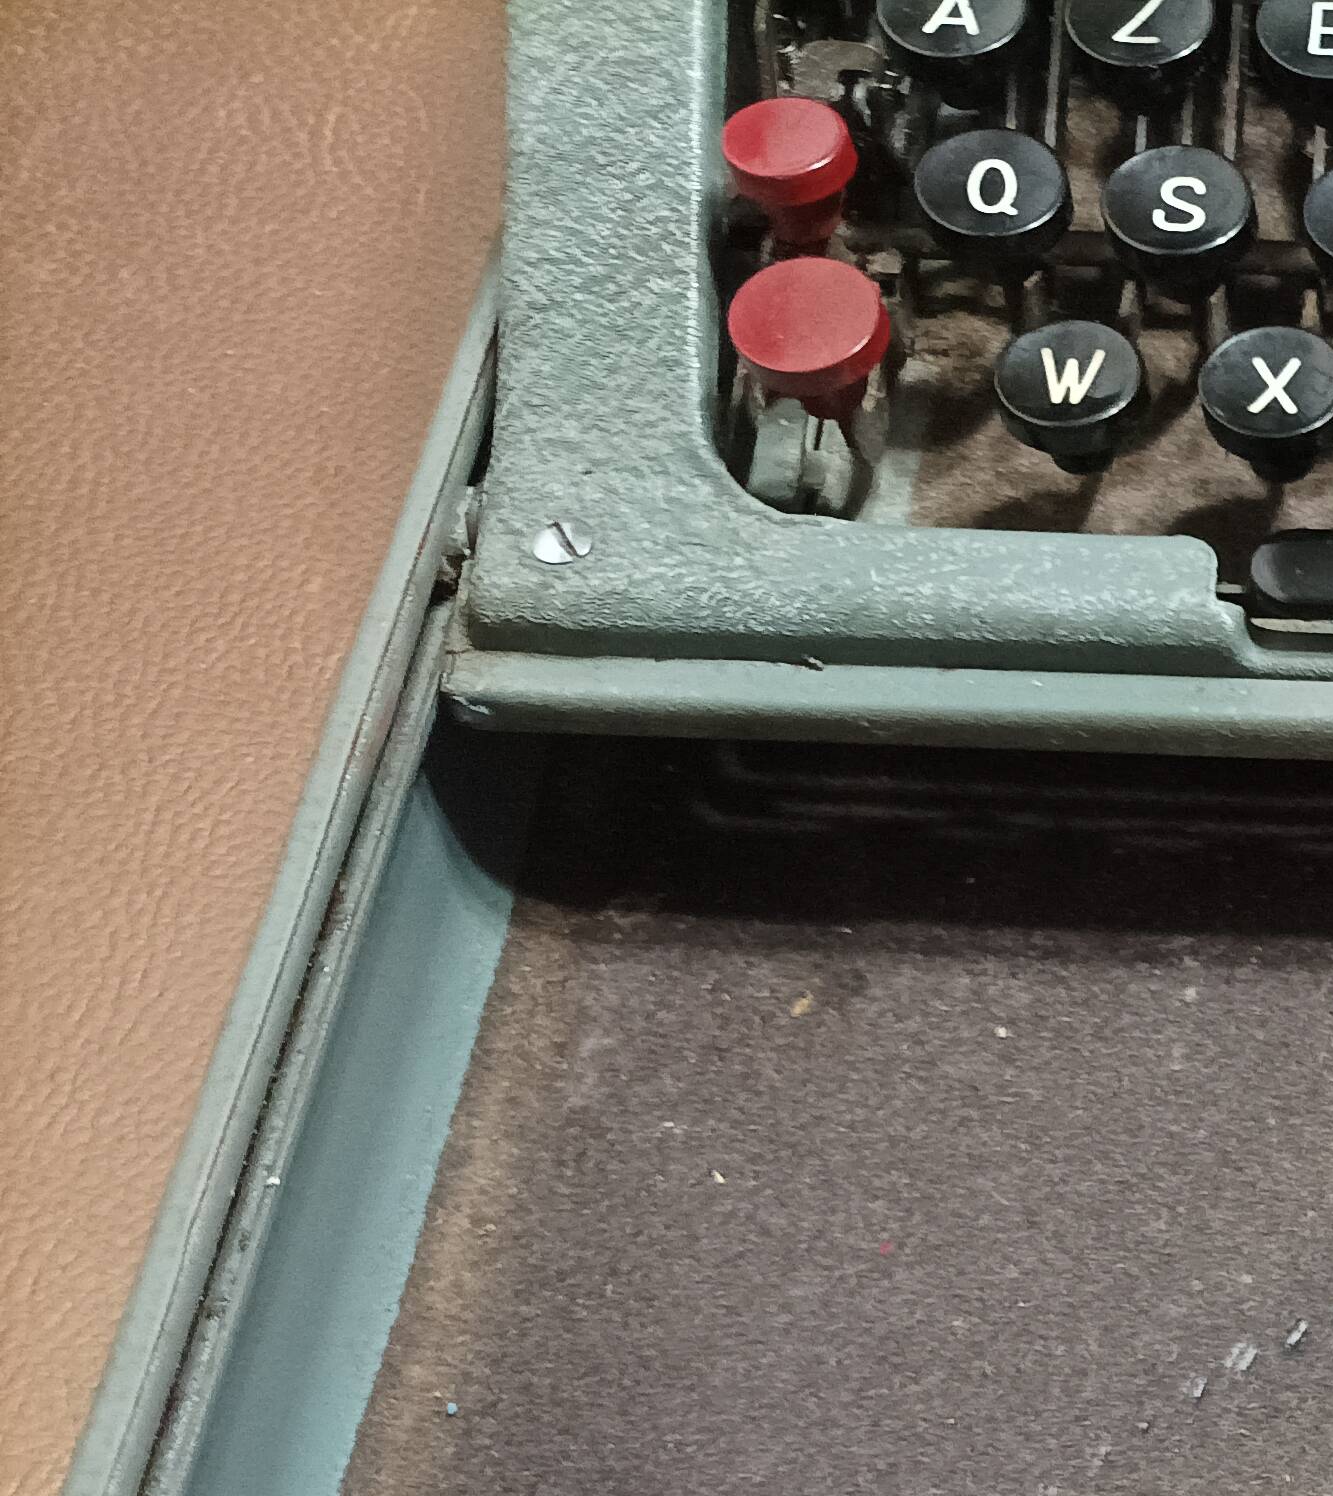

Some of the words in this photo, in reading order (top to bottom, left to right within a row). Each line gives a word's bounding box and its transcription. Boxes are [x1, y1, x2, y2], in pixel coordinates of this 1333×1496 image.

[921, 0, 980, 36] A
[966, 158, 1019, 216] Q
[1152, 176, 1207, 232] S
[1040, 347, 1106, 405] W
[1247, 356, 1302, 415] X
